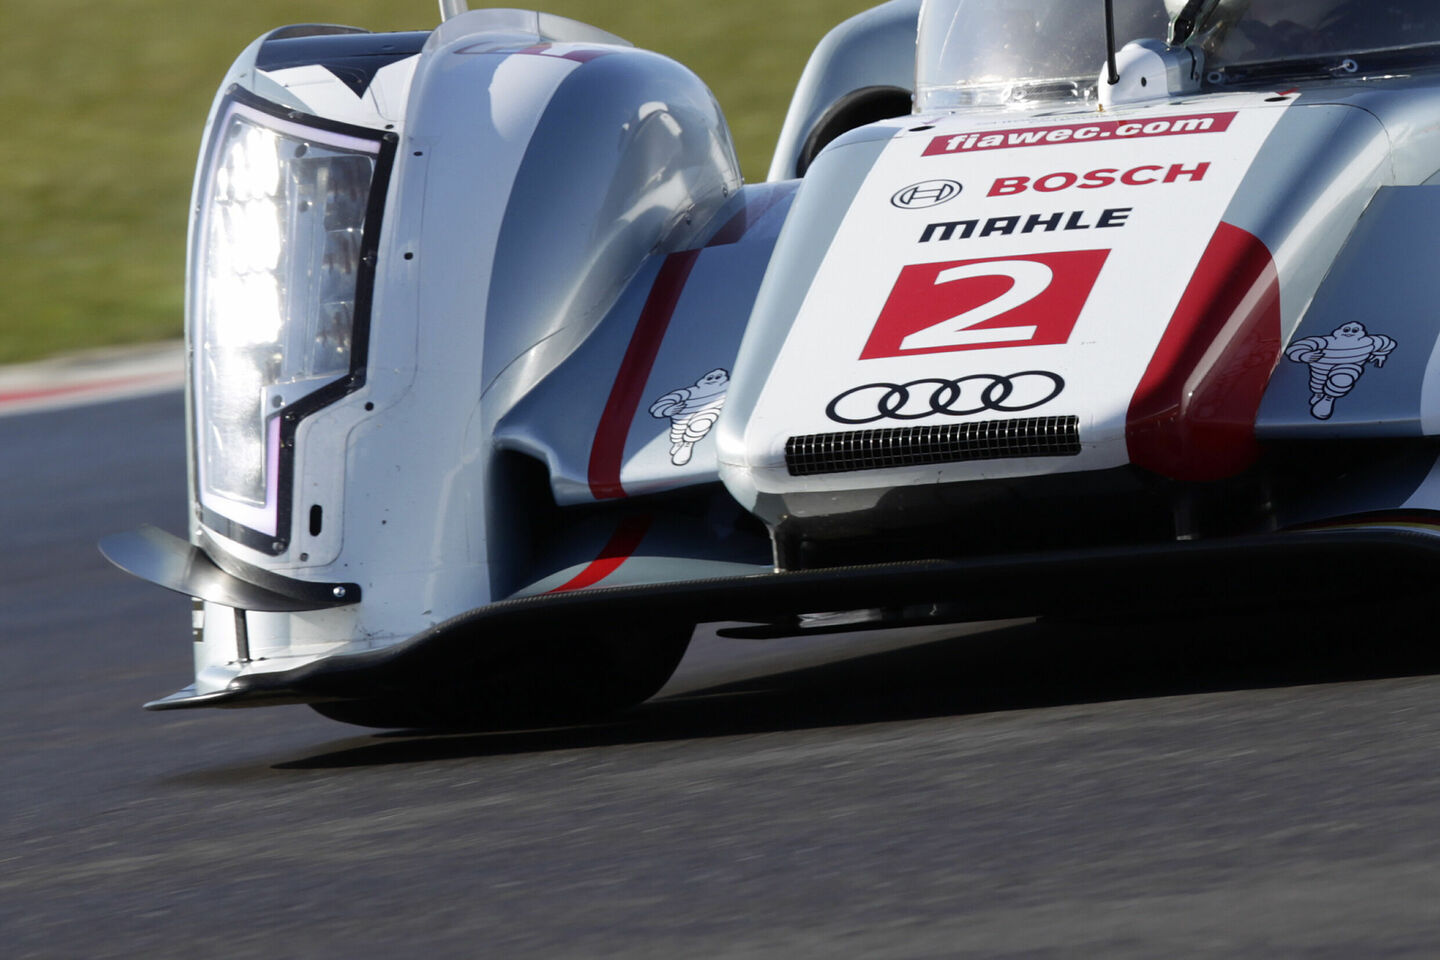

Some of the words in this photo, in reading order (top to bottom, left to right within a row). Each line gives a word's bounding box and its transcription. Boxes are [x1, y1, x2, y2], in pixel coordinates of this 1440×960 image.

[945, 115, 1215, 151] fiawec.com
[986, 161, 1211, 197] BOSCH
[918, 207, 1133, 243] MAHLE
[899, 259, 1053, 350] 2
